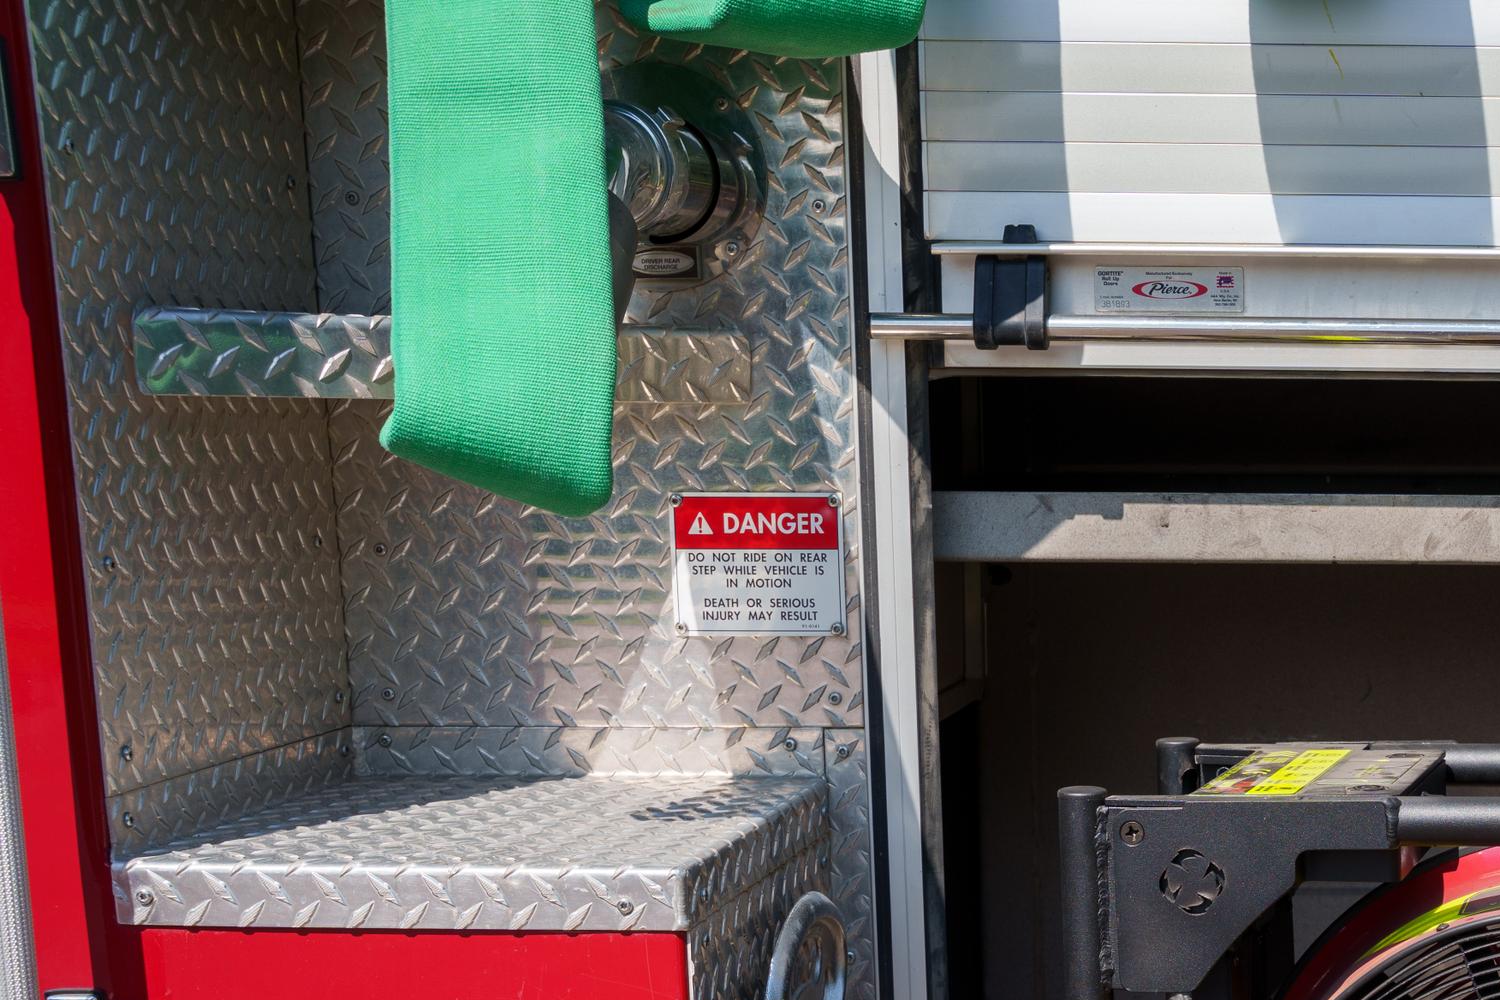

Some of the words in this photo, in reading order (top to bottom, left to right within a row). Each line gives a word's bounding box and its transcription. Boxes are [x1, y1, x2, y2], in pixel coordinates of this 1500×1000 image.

[1148, 282, 1190, 296] Pierce
[723, 512, 825, 535] DANGER
[688, 552, 705, 563] DO
[712, 552, 737, 563] NOT
[743, 552, 767, 563] RIDE
[774, 552, 793, 563] ON
[800, 552, 828, 563] REAR
[692, 566, 716, 575] STEP
[723, 566, 757, 575] WHILE
[765, 566, 808, 575] VEHICLE
[815, 566, 825, 576] IS
[726, 578, 738, 588] IN
[745, 578, 792, 588] MOTION
[704, 598, 739, 608] DEATH
[746, 598, 763, 608] OR
[769, 598, 816, 608] SERIOUS
[702, 611, 741, 621] INJURY
[748, 611, 773, 621] MAY
[780, 611, 818, 621] RESULT
